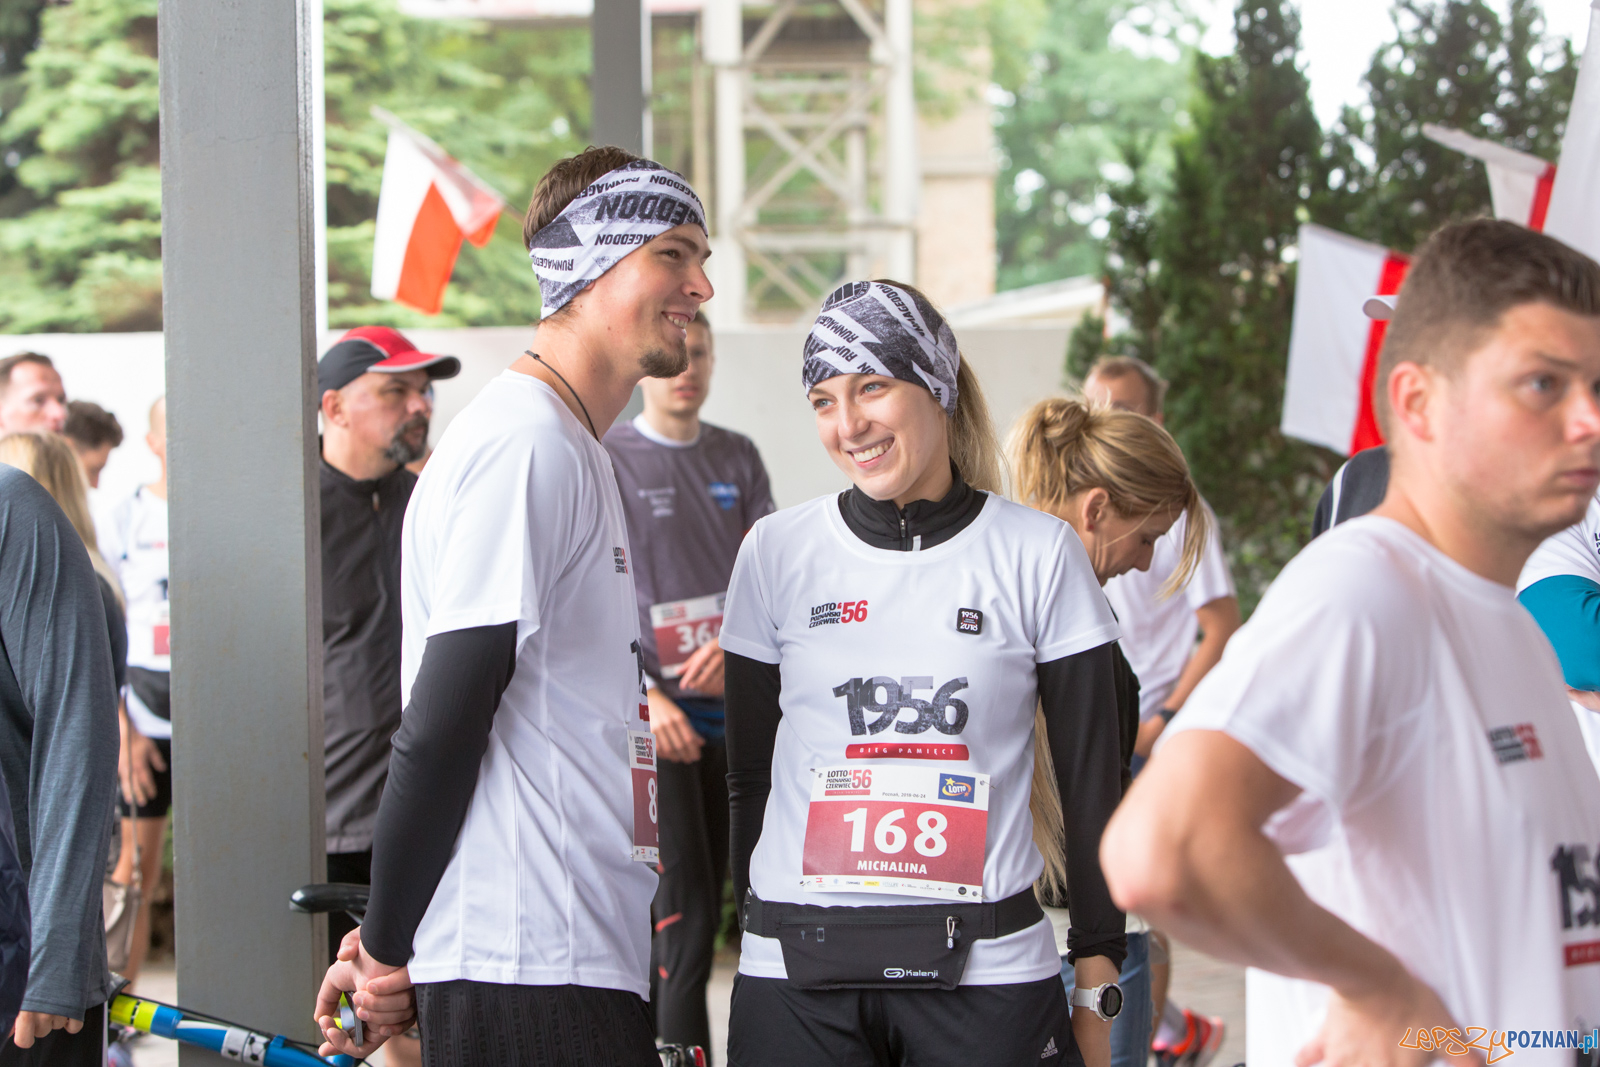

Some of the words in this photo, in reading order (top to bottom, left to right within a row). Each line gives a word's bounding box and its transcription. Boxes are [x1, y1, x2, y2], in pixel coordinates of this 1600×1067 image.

[595, 194, 699, 226] GEDDON
[810, 602, 837, 617] LOTTO
[961, 610, 979, 620] 1956
[808, 617, 841, 629] CZERWIEC
[960, 621, 979, 632] 2018
[676, 620, 720, 654] 36
[832, 675, 970, 736] 1956
[859, 746, 889, 754] BIEG
[898, 747, 954, 756] PAMIĘCI
[827, 769, 849, 778] LOTTO
[948, 784, 967, 794] LOTTO
[843, 807, 948, 858] 168
[857, 860, 928, 875] MICHALINA
[905, 969, 939, 979] Kalenji
[1040, 1048, 1059, 1060] adidas
